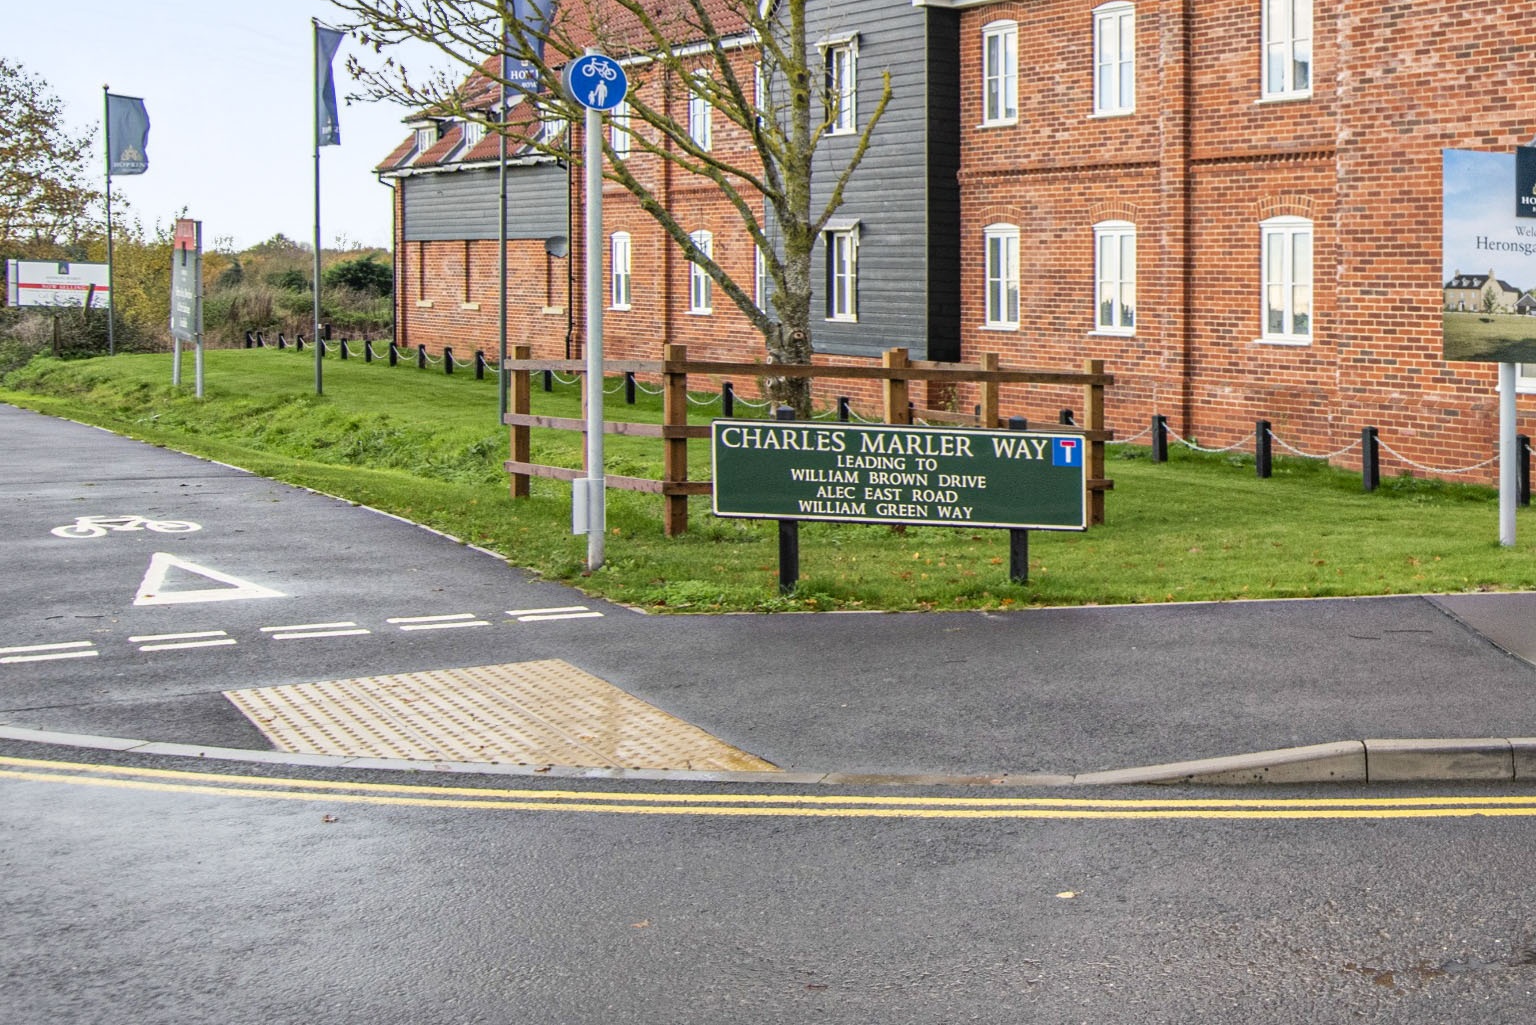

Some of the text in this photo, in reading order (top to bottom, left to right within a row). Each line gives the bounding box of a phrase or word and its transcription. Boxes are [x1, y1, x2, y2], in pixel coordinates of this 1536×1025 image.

[721, 427, 1048, 460] CHARLES MARLER WAY
[837, 455, 938, 472] LEADING TO
[790, 468, 987, 489] WILLIAM BROWN DRIVE
[816, 485, 959, 503] ALEC EAST ROAD
[798, 499, 974, 520] WILLIAM GREEN WAY
